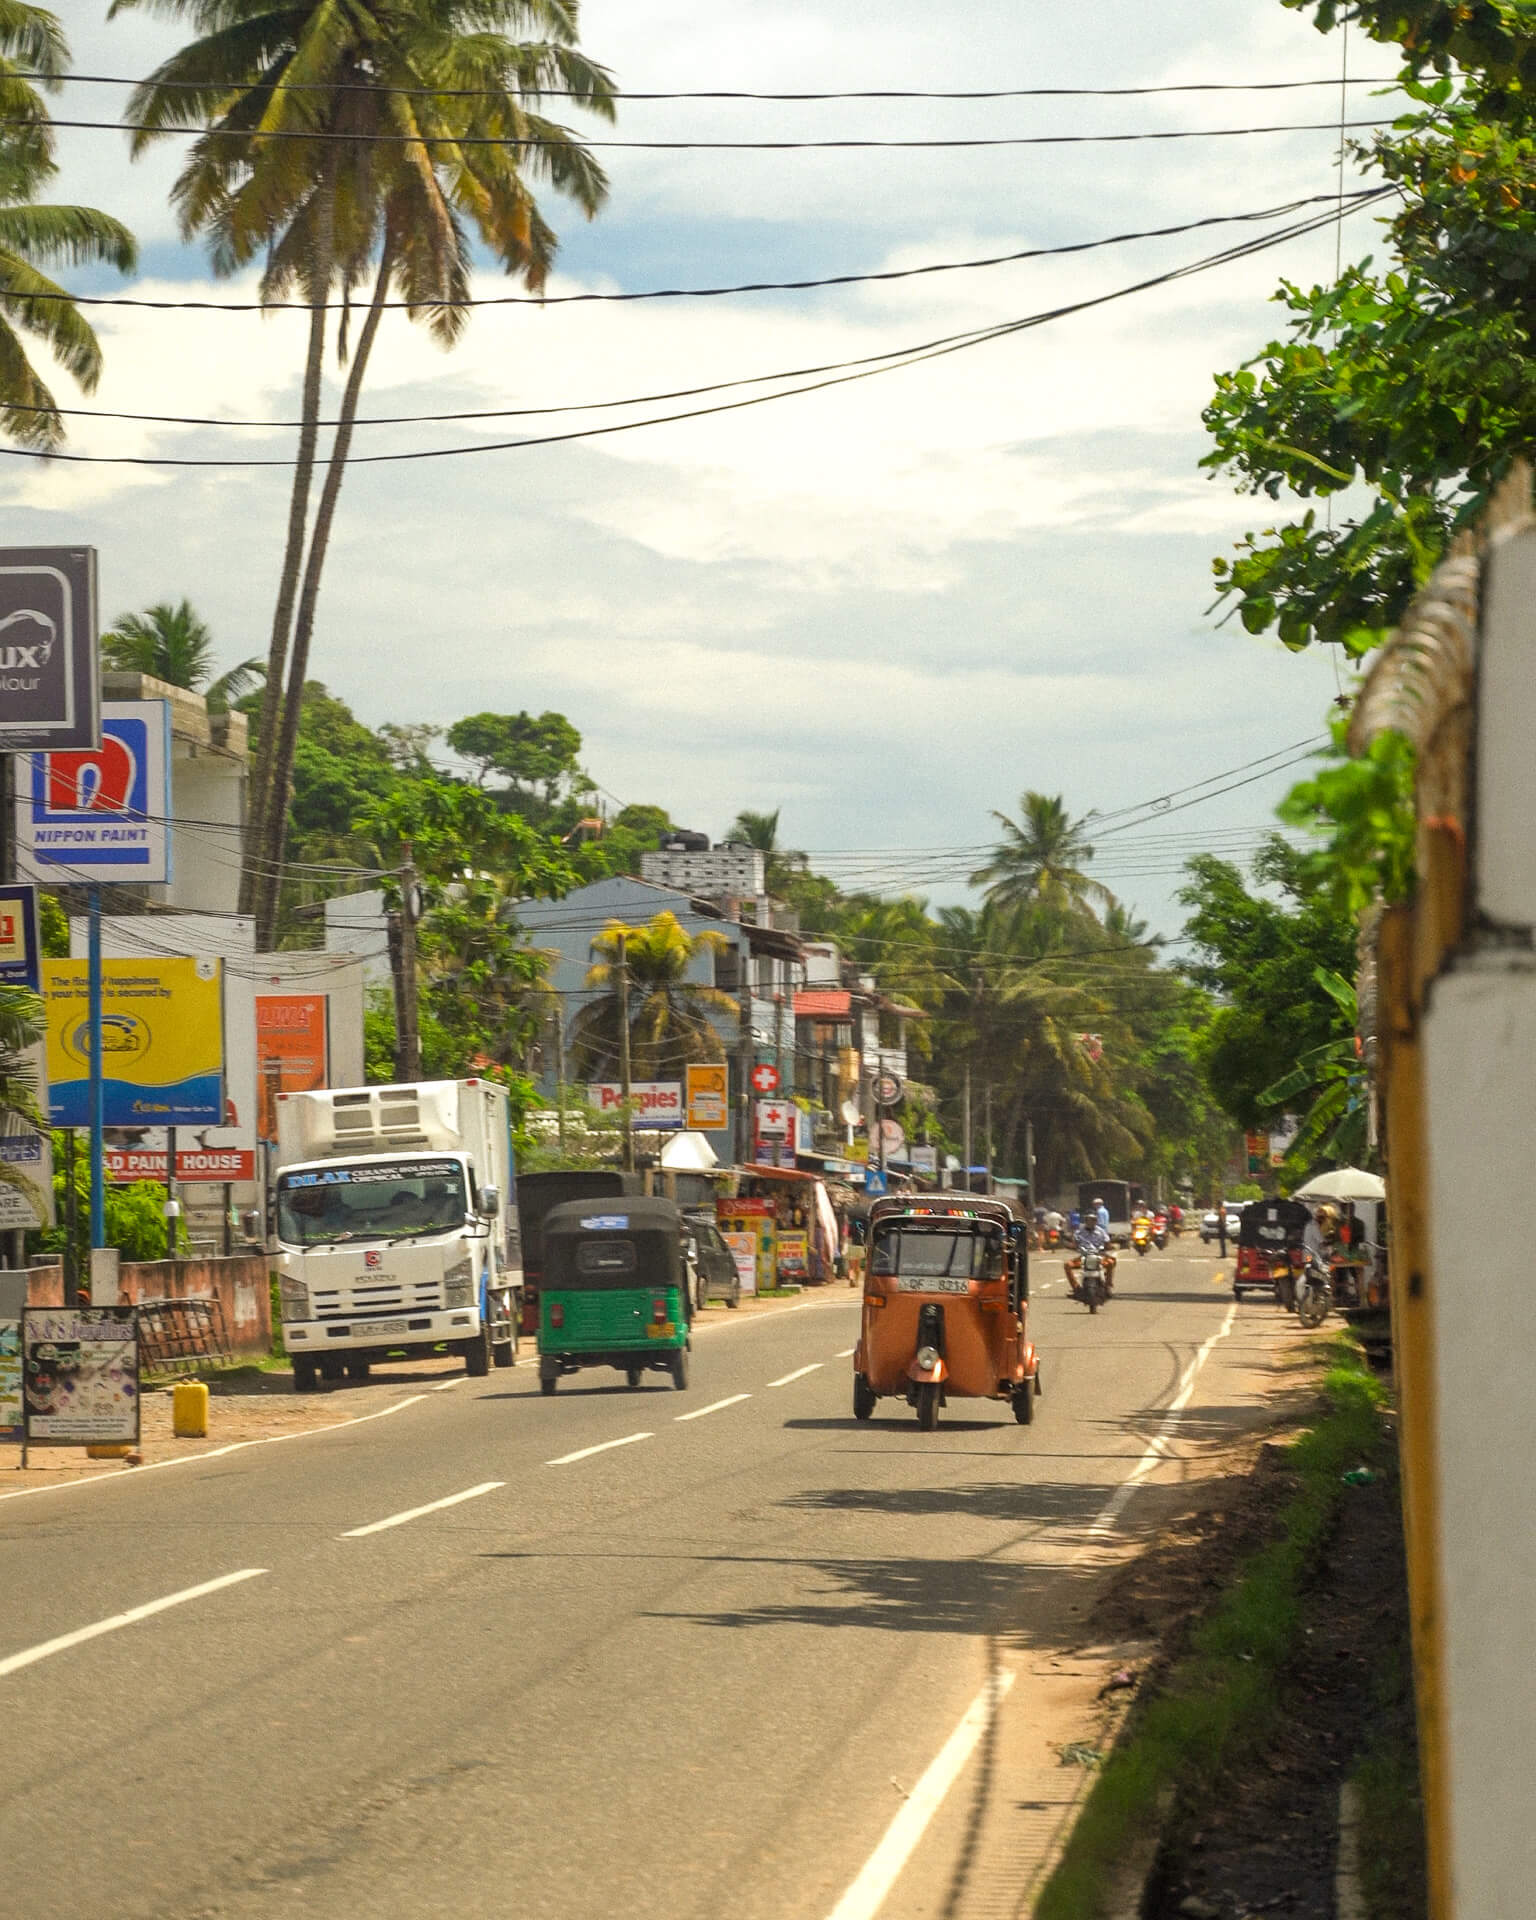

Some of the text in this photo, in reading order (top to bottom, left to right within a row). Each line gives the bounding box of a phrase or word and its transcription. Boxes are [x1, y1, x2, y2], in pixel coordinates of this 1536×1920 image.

[33, 828, 148, 842] NIPPON PAINT
[184, 1154, 242, 1169] HOUSE
